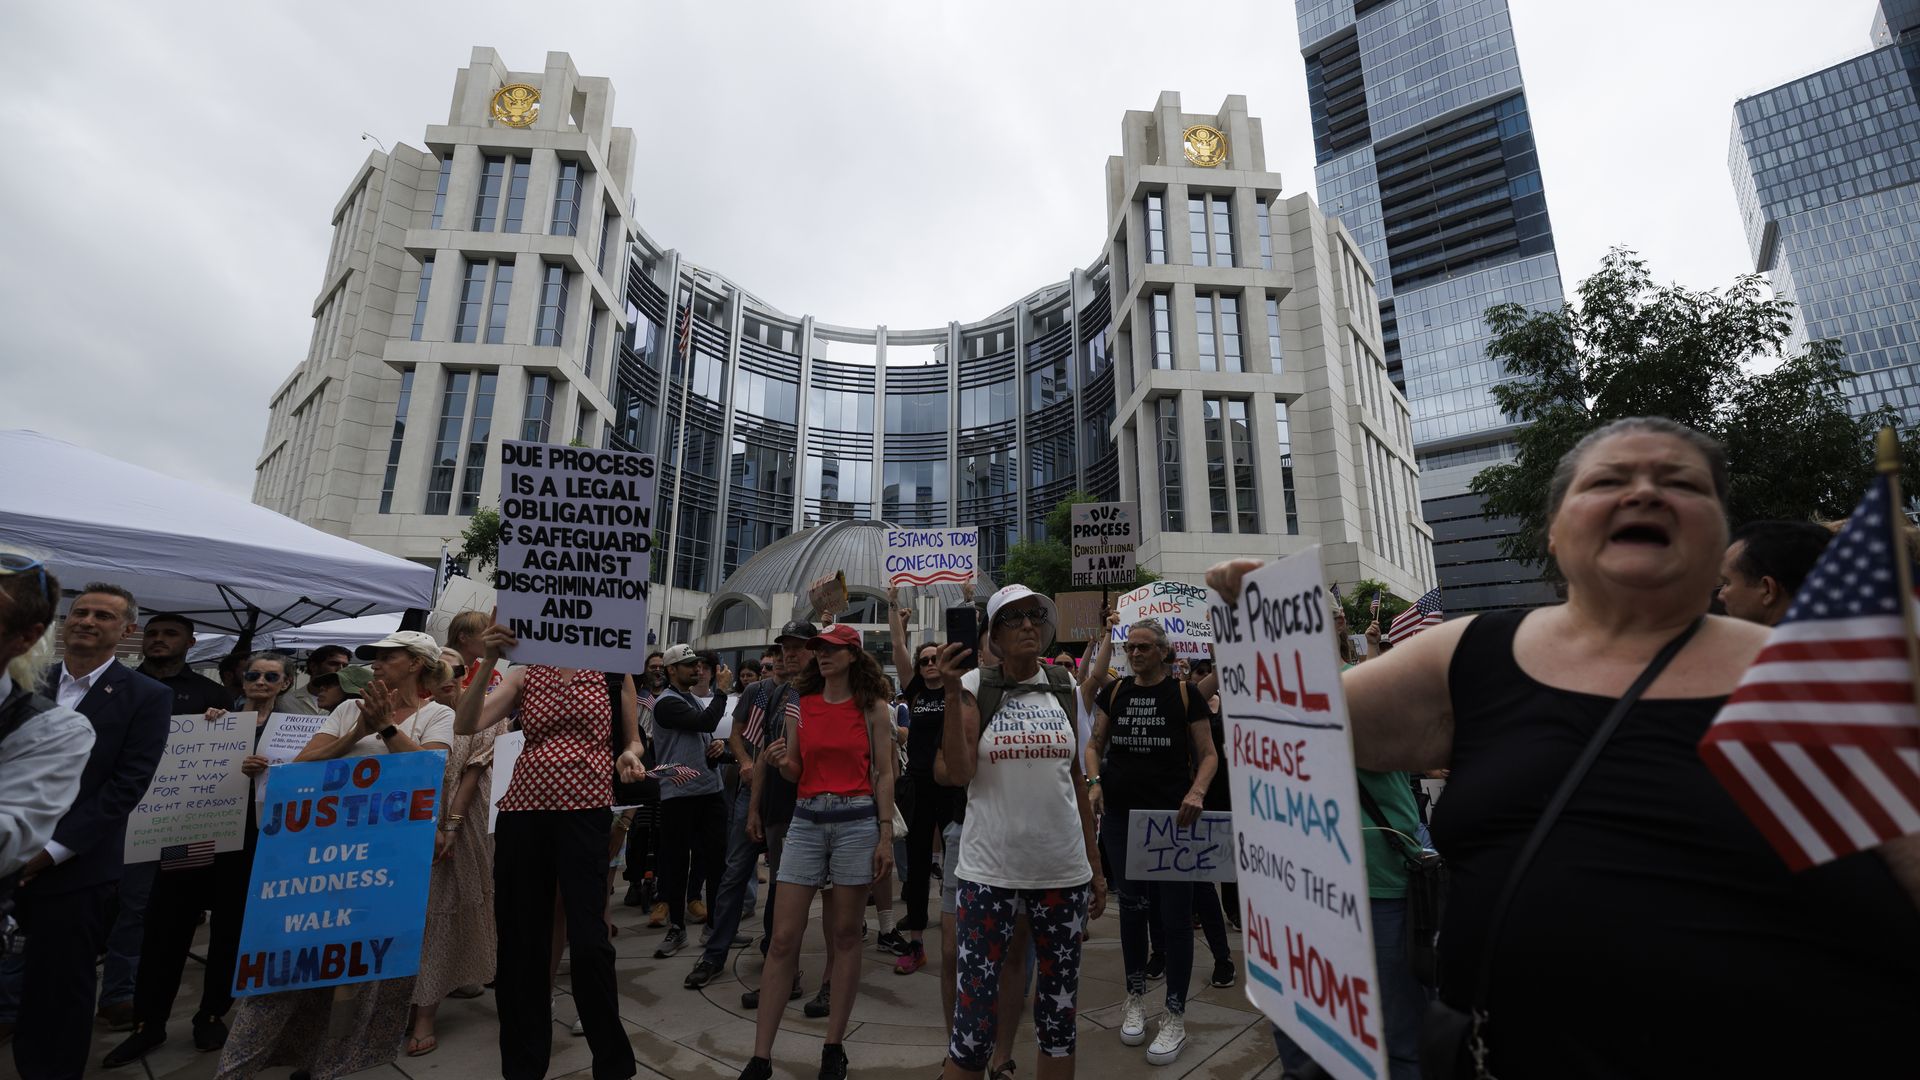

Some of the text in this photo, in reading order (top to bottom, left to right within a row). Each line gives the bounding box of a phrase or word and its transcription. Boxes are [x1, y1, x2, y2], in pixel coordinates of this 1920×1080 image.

[502, 443, 655, 478] DUE PROCESS
[511, 473, 640, 501] IS A LEGAL
[503, 499, 650, 528] OBLIGATION
[1090, 506, 1120, 522] DUE
[517, 525, 651, 553] SAFEGUARD
[888, 531, 978, 548] ESTAMOS TODOS
[1073, 522, 1130, 538] PROCESS
[523, 549, 632, 576] AGAINST
[886, 553, 973, 572] CONECTADOS
[1088, 555, 1126, 571] LAW!
[494, 570, 648, 601] DISCRIMINATION
[1073, 569, 1136, 586] FREE KILMAR!
[1120, 582, 1207, 608] END GESTAPO
[1169, 594, 1194, 608] ICE
[540, 598, 593, 620] AND
[1138, 602, 1181, 618] RAIDS
[1211, 581, 1324, 644] DUE PROCESS
[509, 618, 632, 650] INJUSTICE
[1164, 617, 1185, 634] NO
[1186, 620, 1210, 631] KINGS
[1222, 650, 1331, 712] FOR ALL
[1129, 697, 1156, 706] PRISON
[1117, 716, 1166, 726] DUE PROCESS
[1126, 707, 1157, 716] WITHOUT
[169, 716, 238, 734] DO THE
[993, 721, 1064, 734] that your
[1131, 727, 1147, 736] IS A
[209, 741, 247, 752] THING
[994, 731, 1067, 745] racism is
[1111, 736, 1171, 747] CONCENTRATION
[989, 745, 1071, 764] patriotism
[1233, 723, 1311, 781] RELEASE
[178, 759, 230, 769] IN THE
[153, 772, 229, 783] IGHT WAY
[322, 758, 381, 792] DO
[152, 785, 216, 797] FOR THE
[137, 802, 181, 813] RIGHT
[152, 815, 180, 825] BEN
[1250, 775, 1352, 864] KILMAR
[1144, 815, 1232, 847] MELT
[308, 843, 369, 864] LOVE
[1147, 844, 1219, 872] ICE
[260, 868, 395, 899] KINDNESS,
[1301, 867, 1362, 933] THEM
[284, 908, 352, 933] WALK
[235, 937, 394, 991] HUMBLY
[1247, 897, 1378, 1051] ALL HOME
